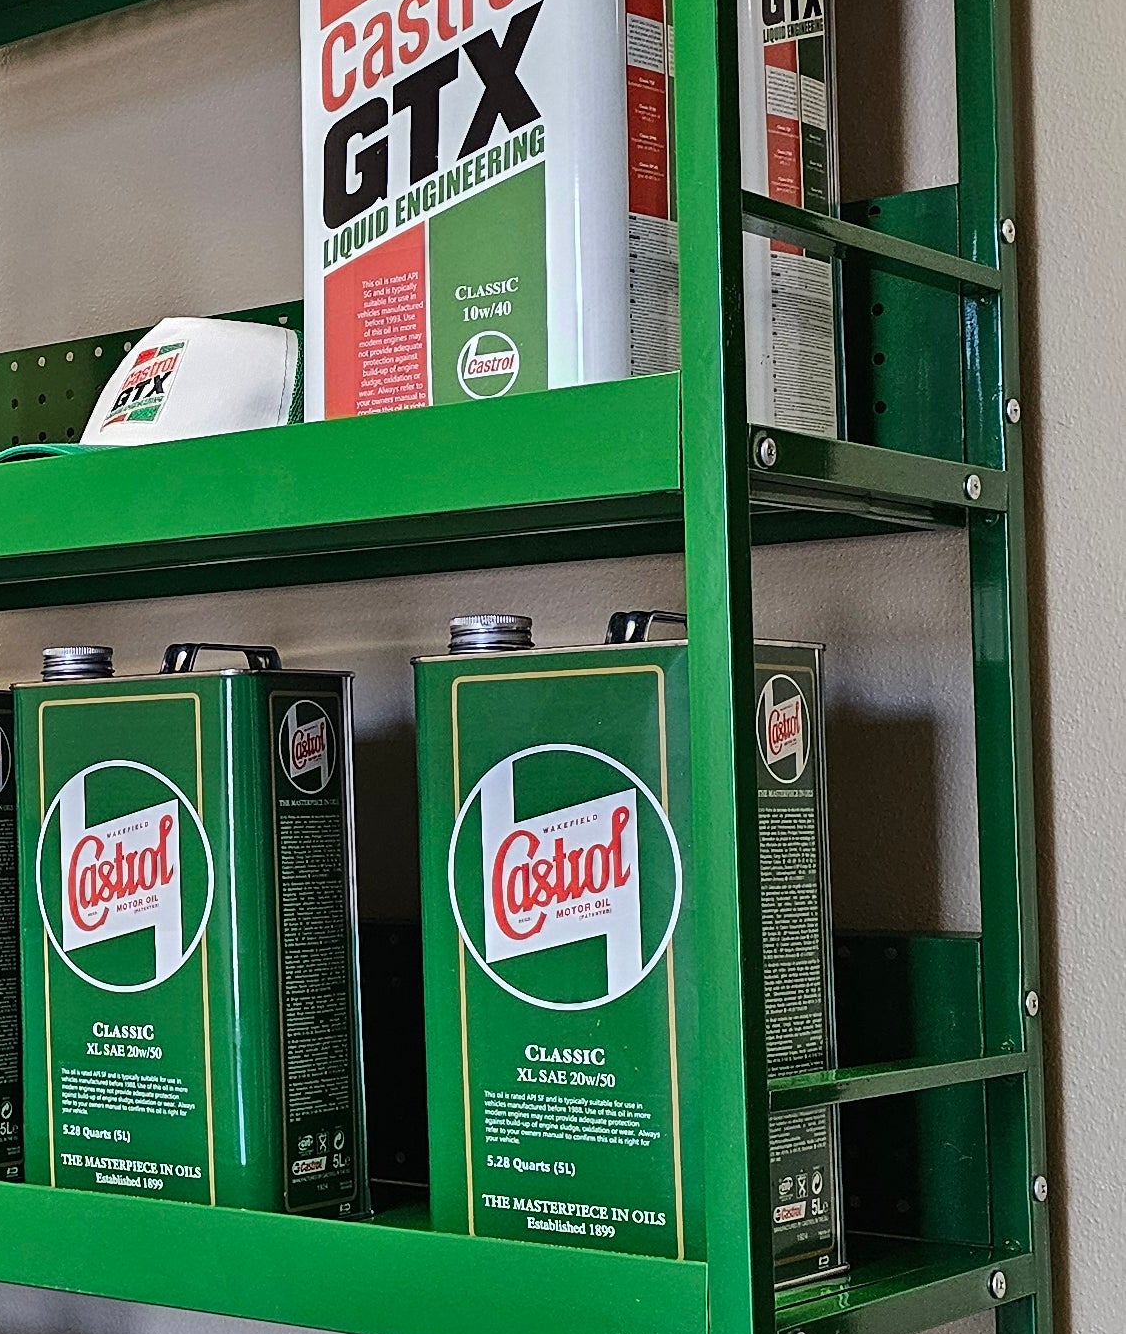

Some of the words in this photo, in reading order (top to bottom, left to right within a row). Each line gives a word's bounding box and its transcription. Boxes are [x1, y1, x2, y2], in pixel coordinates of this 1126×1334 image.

[323, 205, 388, 268] LIQUID
[396, 124, 544, 227] ENGINEERING
[362, 280, 373, 288] This
[463, 301, 512, 322] 10w/40
[468, 354, 515, 375] Castrol
[111, 371, 173, 412] GTX
[768, 701, 800, 755] Castrol
[292, 722, 326, 770] Castrol
[107, 821, 149, 839] WAKEFIELD
[543, 814, 598, 834] WAKEFIELD
[67, 814, 174, 931] Castrol
[492, 805, 631, 940] Castrol
[116, 898, 143, 912] MOTOR
[145, 895, 159, 904] OIL
[556, 902, 591, 918] MOTOR
[594, 898, 611, 909] OIL
[86, 1043, 103, 1055] XL
[103, 1043, 125, 1057] SAE
[126, 1045, 162, 1059] 20w/50
[516, 1067, 537, 1082] XL
[538, 1069, 567, 1084] SAE
[569, 1071, 616, 1087] 20w/50
[546, 1095, 556, 1103] and
[564, 1096, 588, 1106] typically
[590, 1099, 612, 1107] suitable
[614, 1099, 623, 1108] for
[62, 1124, 81, 1136] 5.28
[82, 1126, 111, 1140] Quarts
[114, 1130, 131, 1143] (5L)
[60, 1153, 83, 1166] THE
[84, 1156, 158, 1175] MASTERPIECE
[160, 1162, 173, 1175] IN
[175, 1164, 202, 1179] OILS
[486, 1154, 510, 1168] 5.28
[512, 1157, 551, 1173] Quarts
[553, 1162, 576, 1177] (5L)
[95, 1172, 141, 1188] Established
[143, 1177, 163, 1190] 1899
[481, 1193, 510, 1209] THE
[512, 1197, 609, 1220] MASTERPIECE
[611, 1207, 629, 1222] IN
[631, 1210, 666, 1226] OILS
[527, 1216, 586, 1235] Established
[589, 1223, 616, 1238] 1899
